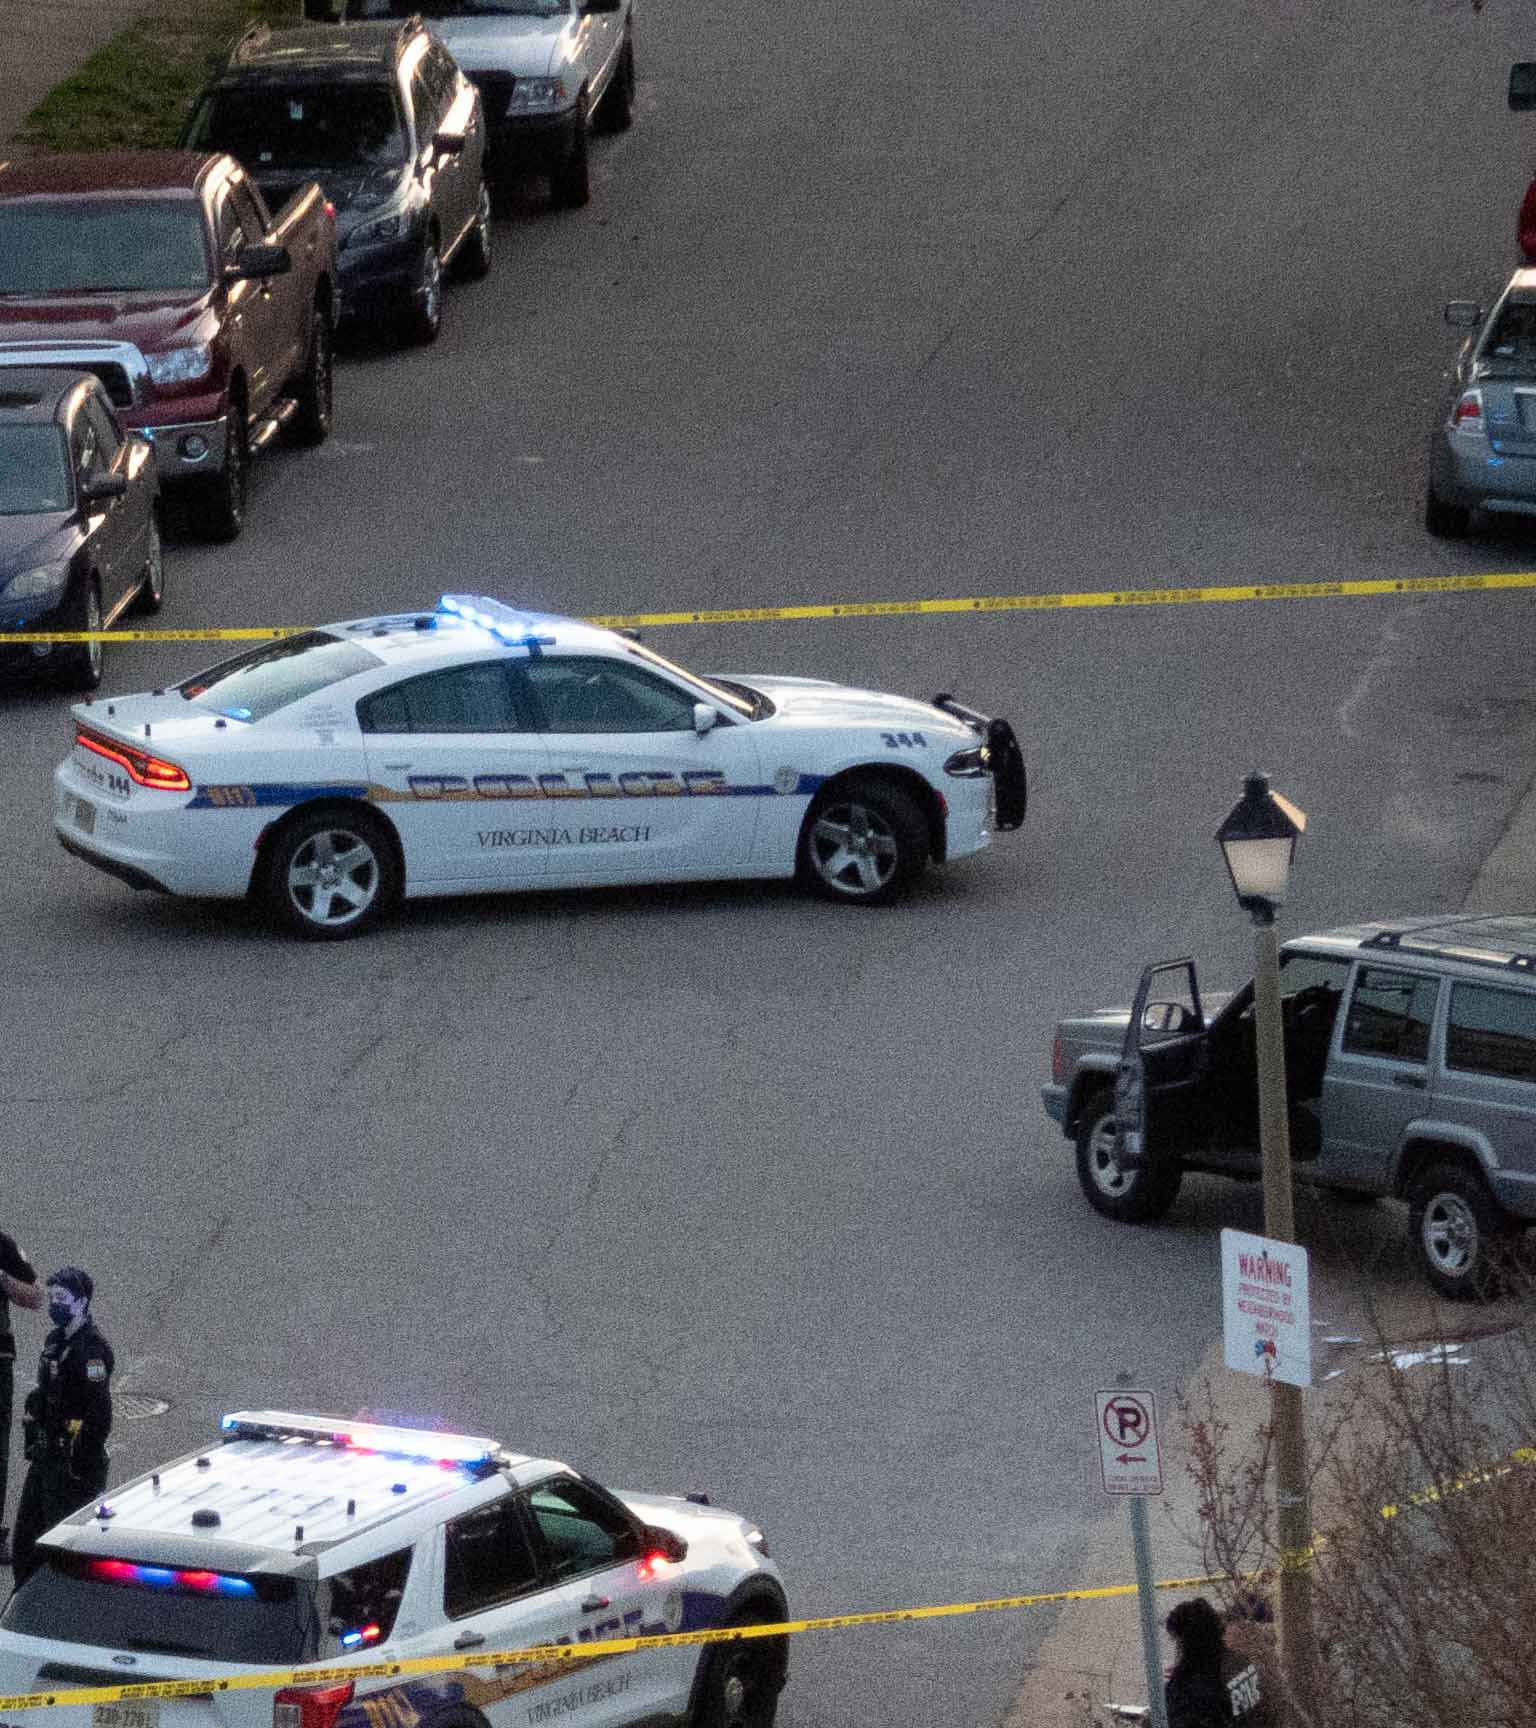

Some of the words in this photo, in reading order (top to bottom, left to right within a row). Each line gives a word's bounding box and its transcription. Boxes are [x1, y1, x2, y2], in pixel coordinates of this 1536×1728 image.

[408, 770, 726, 800] POLICE
[478, 828, 571, 848] VIRGINIA
[578, 826, 650, 844] BEACH
[1238, 1254, 1292, 1288] WARNING
